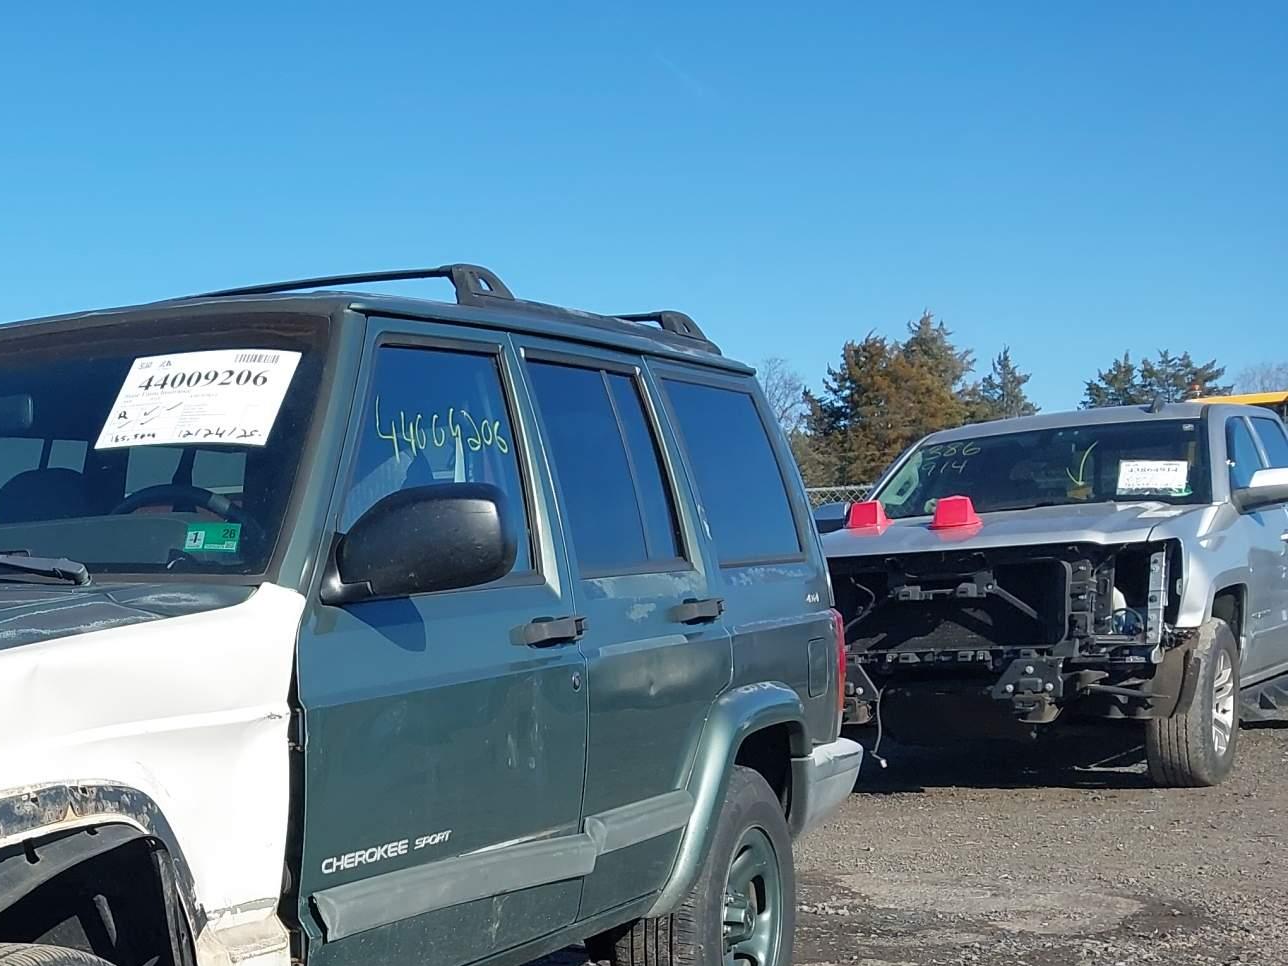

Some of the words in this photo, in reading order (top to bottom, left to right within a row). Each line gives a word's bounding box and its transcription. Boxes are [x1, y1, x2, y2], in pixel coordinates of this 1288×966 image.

[139, 369, 268, 391] 44009206
[321, 839, 409, 874] CHEROKEE
[414, 829, 453, 850] SPORT
